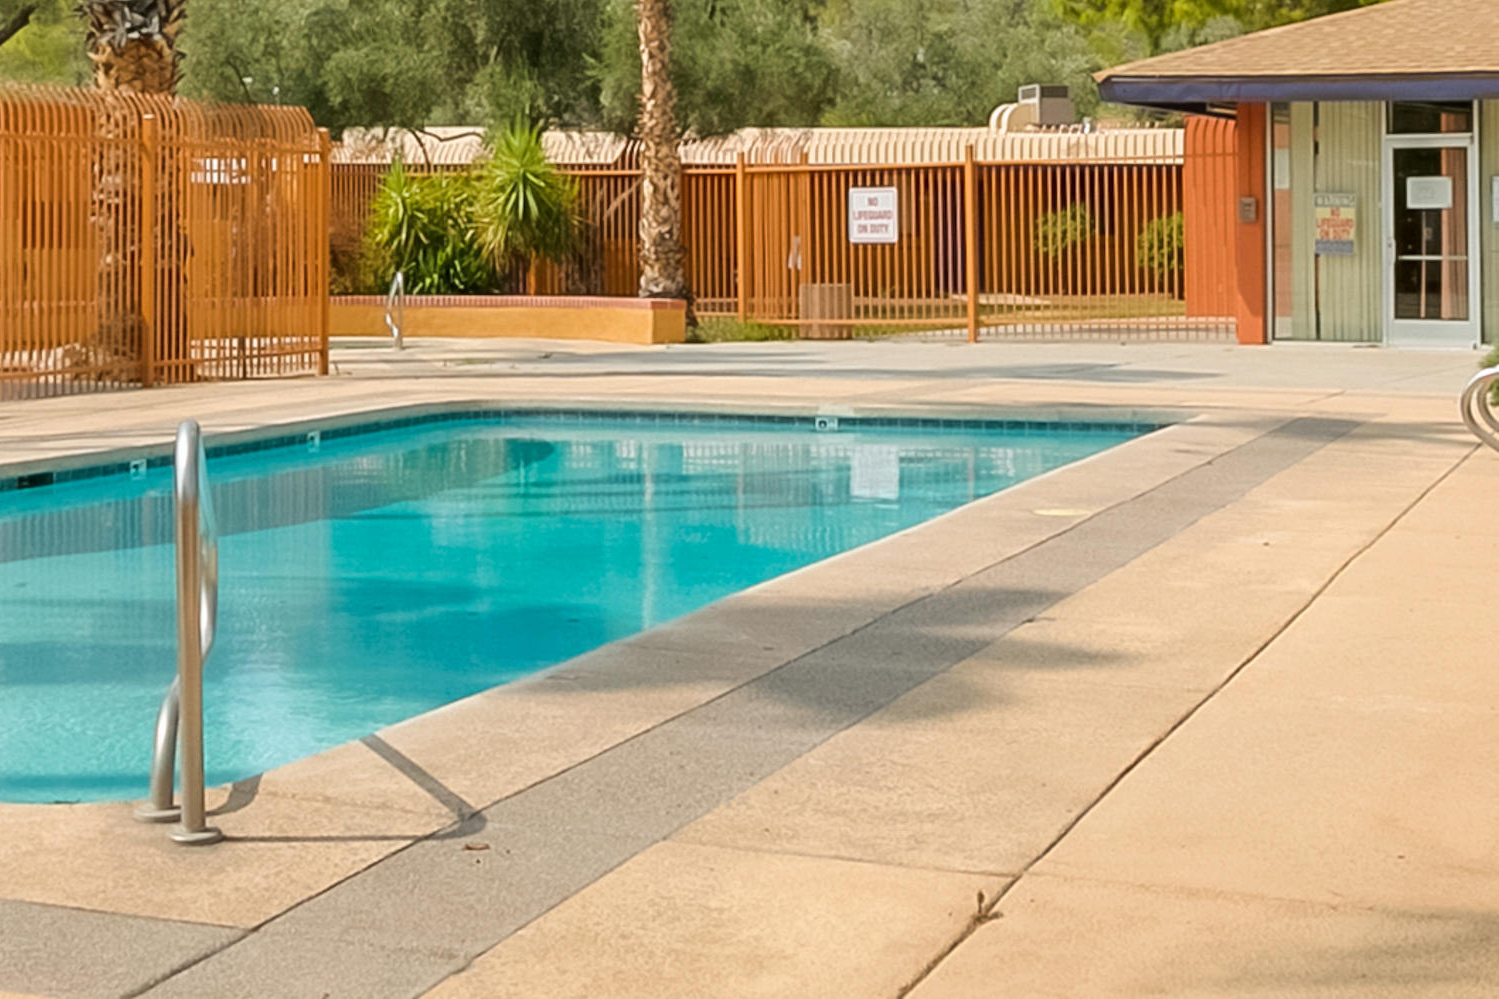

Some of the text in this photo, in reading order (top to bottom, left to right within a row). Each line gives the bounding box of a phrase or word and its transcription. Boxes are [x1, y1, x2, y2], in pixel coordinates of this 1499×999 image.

[867, 197, 878, 206] NO
[853, 210, 892, 220] LIFEGUARD
[857, 224, 888, 233] ON DUTY
